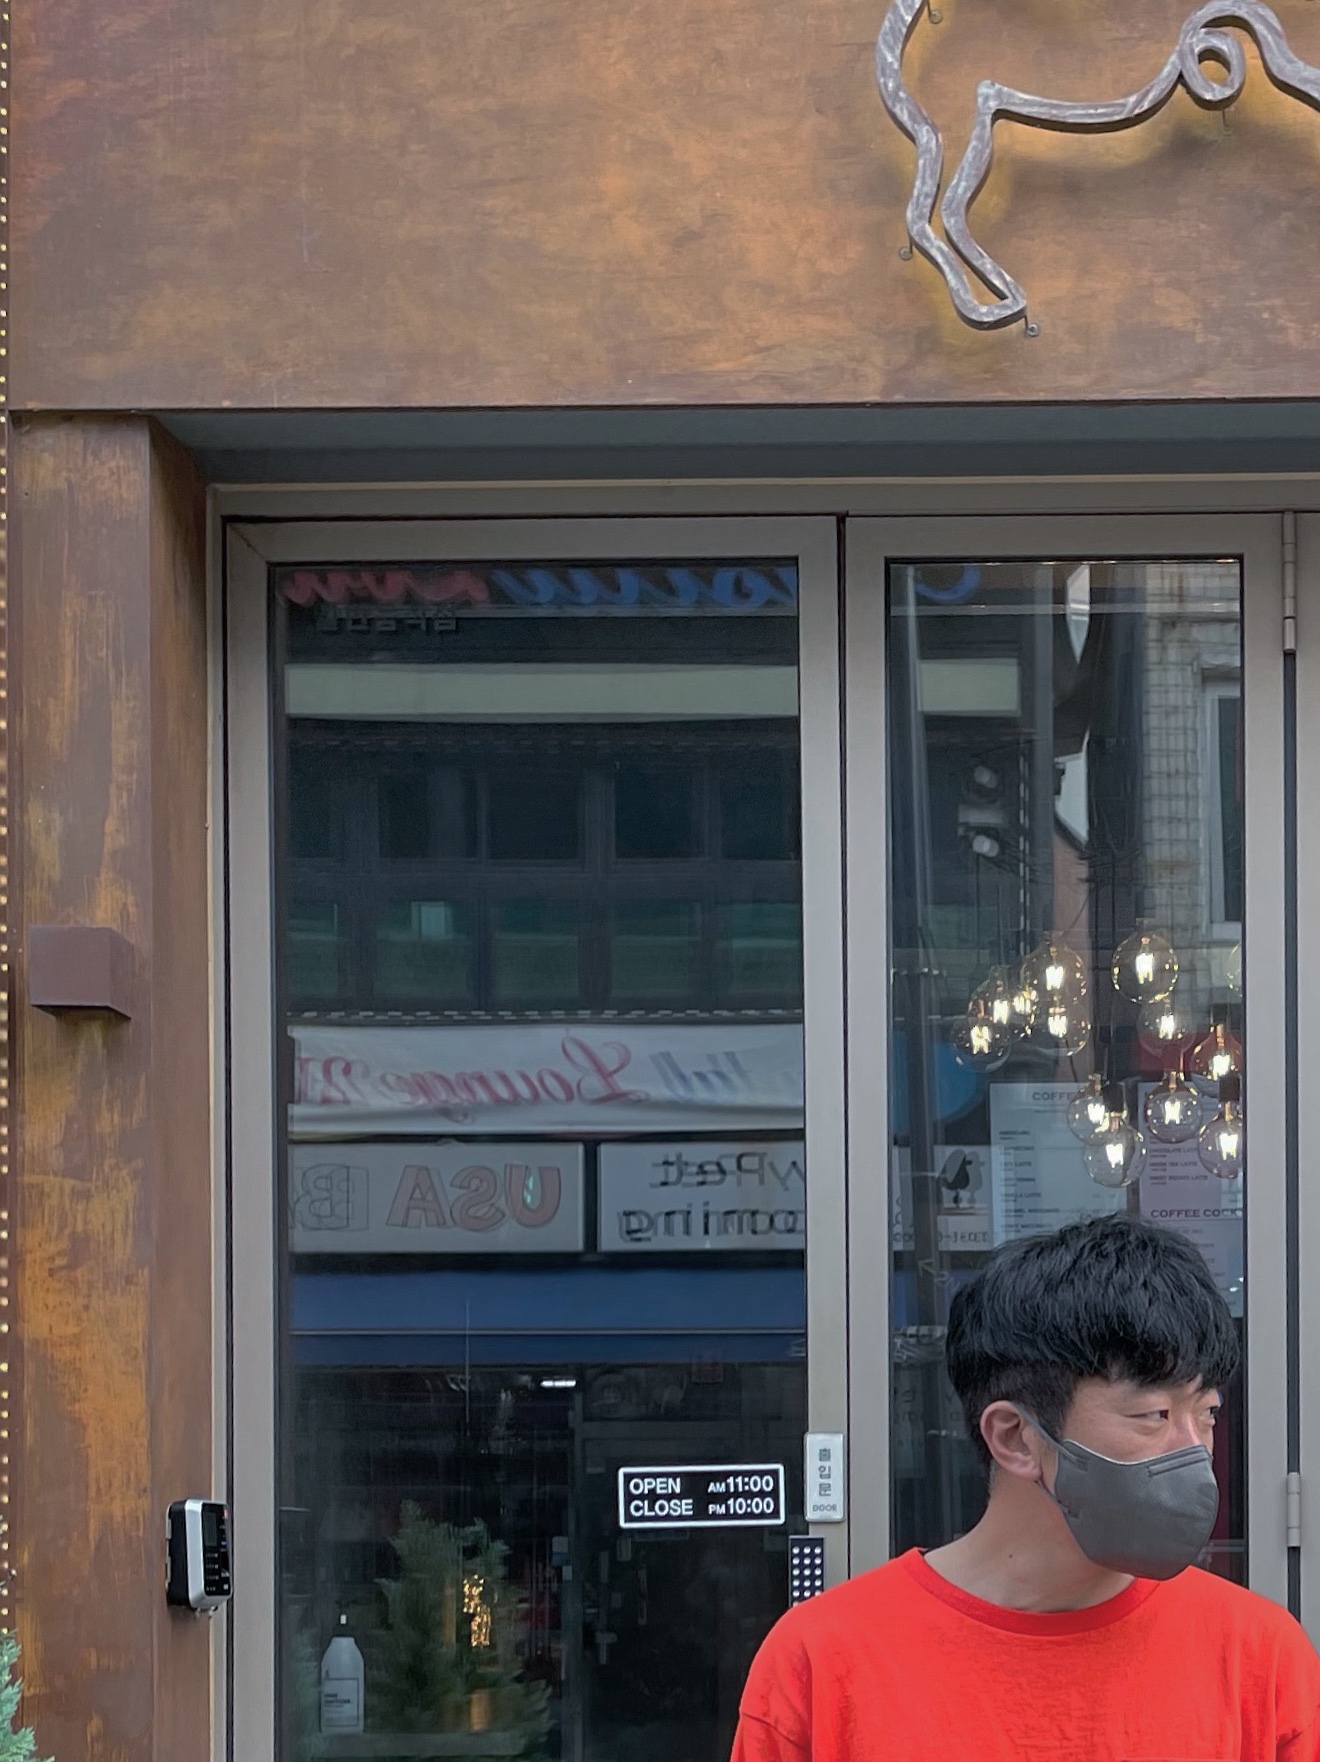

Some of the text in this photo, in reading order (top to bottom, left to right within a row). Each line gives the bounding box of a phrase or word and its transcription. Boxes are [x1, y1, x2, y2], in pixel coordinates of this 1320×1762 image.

[1150, 1208, 1201, 1219] COFFEE
[629, 1478, 681, 1495] OPEN
[630, 1499, 694, 1517] CLOSE
